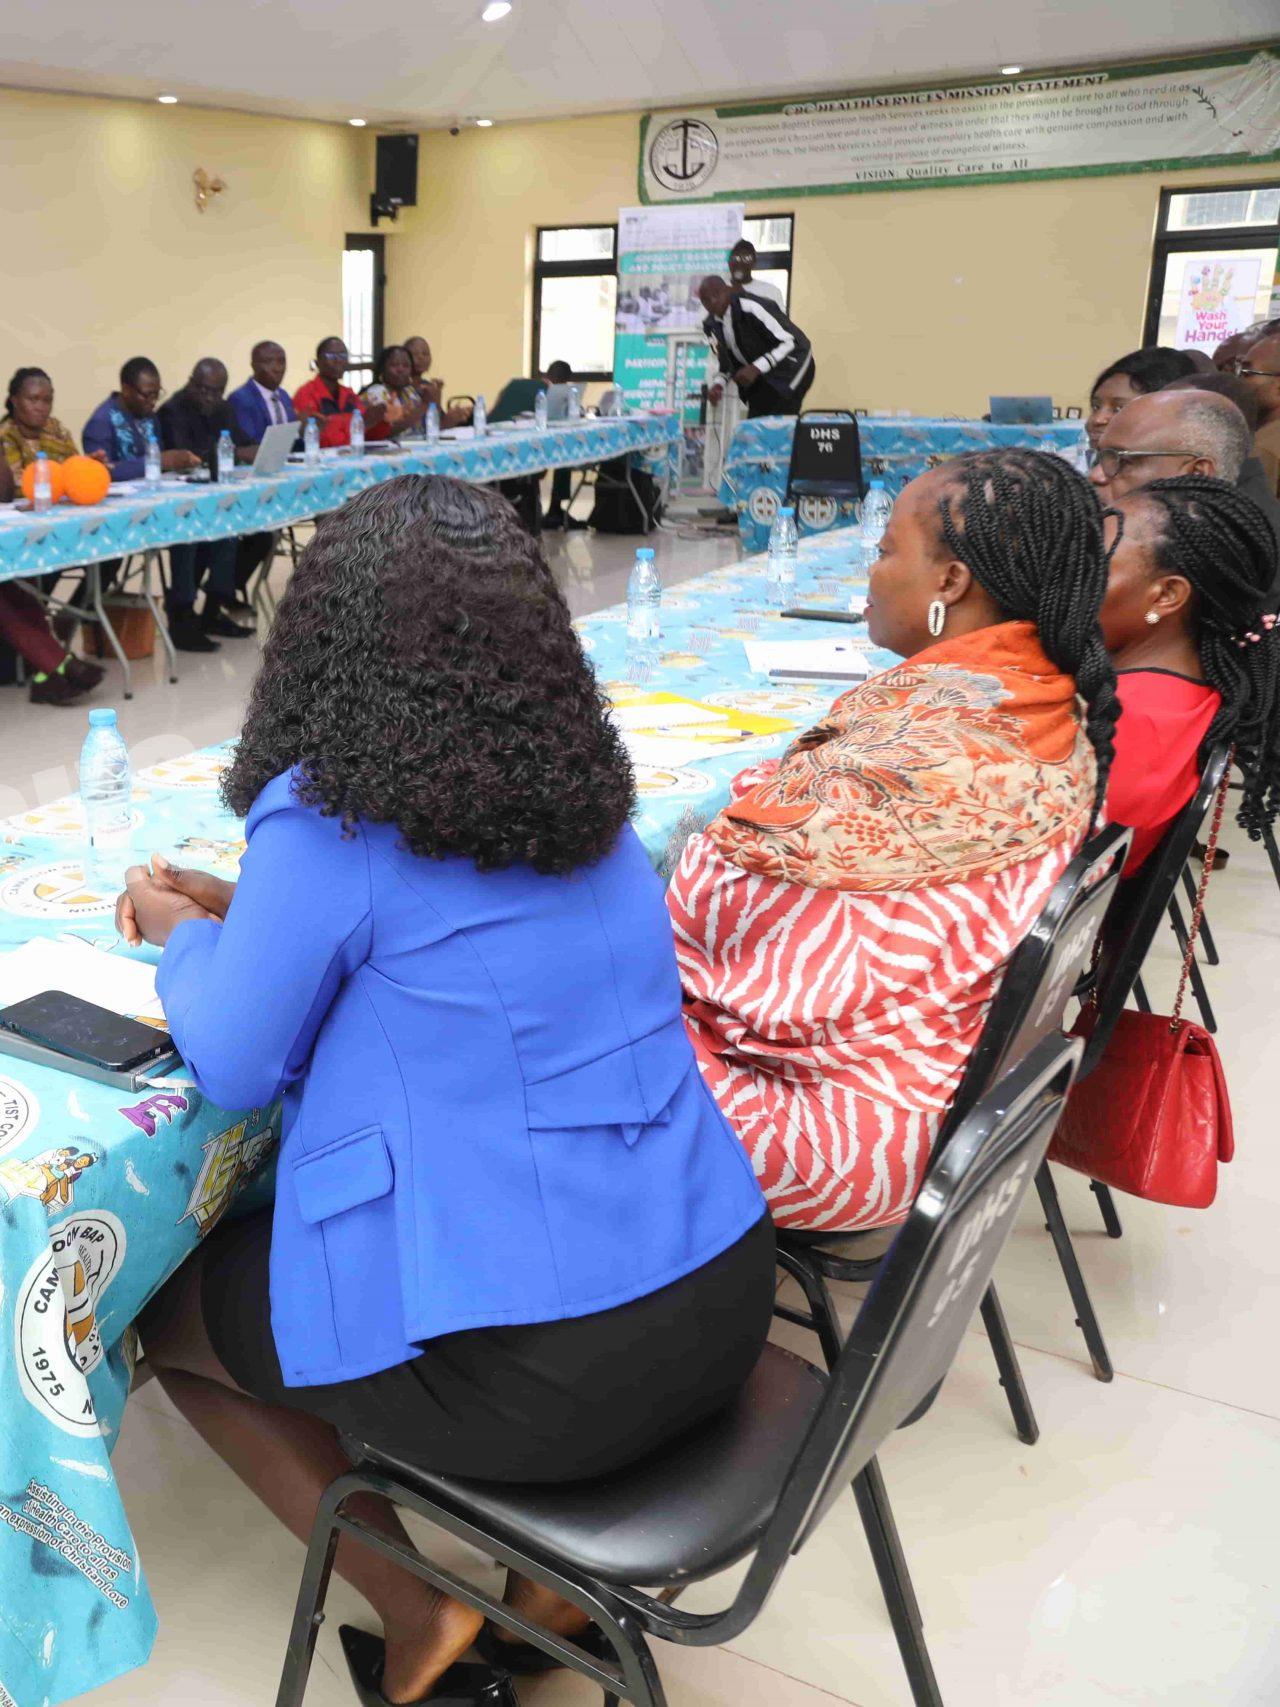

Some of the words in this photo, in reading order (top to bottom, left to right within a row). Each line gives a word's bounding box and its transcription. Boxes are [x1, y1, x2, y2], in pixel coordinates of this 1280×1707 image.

[783, 104, 815, 116] CBC
[817, 98, 871, 112] HEALTH
[876, 94, 943, 107] SERVICES
[947, 84, 1012, 100] MISSION
[1017, 75, 1106, 94] STATEMENT
[961, 103, 987, 114] assist
[1000, 100, 1014, 109] the
[1015, 97, 1058, 109] provision
[1060, 94, 1070, 104] of
[1072, 92, 1093, 102] care
[1094, 91, 1104, 100] to
[1106, 88, 1119, 99] all
[1120, 87, 1141, 98] who
[1142, 84, 1167, 95] need
[1178, 84, 1191, 92] as
[920, 120, 953, 131] witness
[965, 116, 988, 126] order
[990, 115, 1009, 125] that
[1011, 113, 1030, 124] they
[1032, 109, 1060, 121] might
[1062, 107, 1073, 117] be
[1075, 105, 1113, 118] brought
[1127, 101, 1146, 111] God
[1149, 98, 1189, 111] through
[926, 131, 970, 145] exemplary
[974, 128, 1002, 139] health
[1003, 127, 1023, 137] care
[1024, 124, 1045, 135] with
[1046, 122, 1084, 135] genuine
[1086, 117, 1142, 131] compassion
[1145, 115, 1164, 125] and
[1166, 112, 1188, 123] with
[942, 143, 990, 156] evangelical
[906, 164, 948, 178] Quality
[957, 163, 984, 173] Care
[992, 161, 1004, 170] to
[1011, 158, 1028, 169] All
[1196, 311, 1226, 321] Wash
[1199, 320, 1227, 330] Your
[810, 428, 840, 441] DHS
[817, 442, 833, 453] 76
[3, 1098, 20, 1122] TIST
[947, 1160, 1028, 1275] DHS
[80, 1226, 105, 1244] BAP
[32, 1346, 65, 1397] 1975
[27, 1481, 66, 1514] Assisting
[64, 1511, 77, 1523] in
[75, 1521, 93, 1538] the
[91, 1536, 131, 1571] Provision
[31, 1503, 56, 1527] Health
[57, 1522, 79, 1544] Care
[79, 1543, 91, 1555] to
[90, 1555, 104, 1569] all
[102, 1567, 117, 1579] as
[10, 1514, 50, 1542] expression
[50, 1538, 64, 1549] of
[62, 1546, 104, 1586] Christian
[103, 1583, 127, 1607] Love
